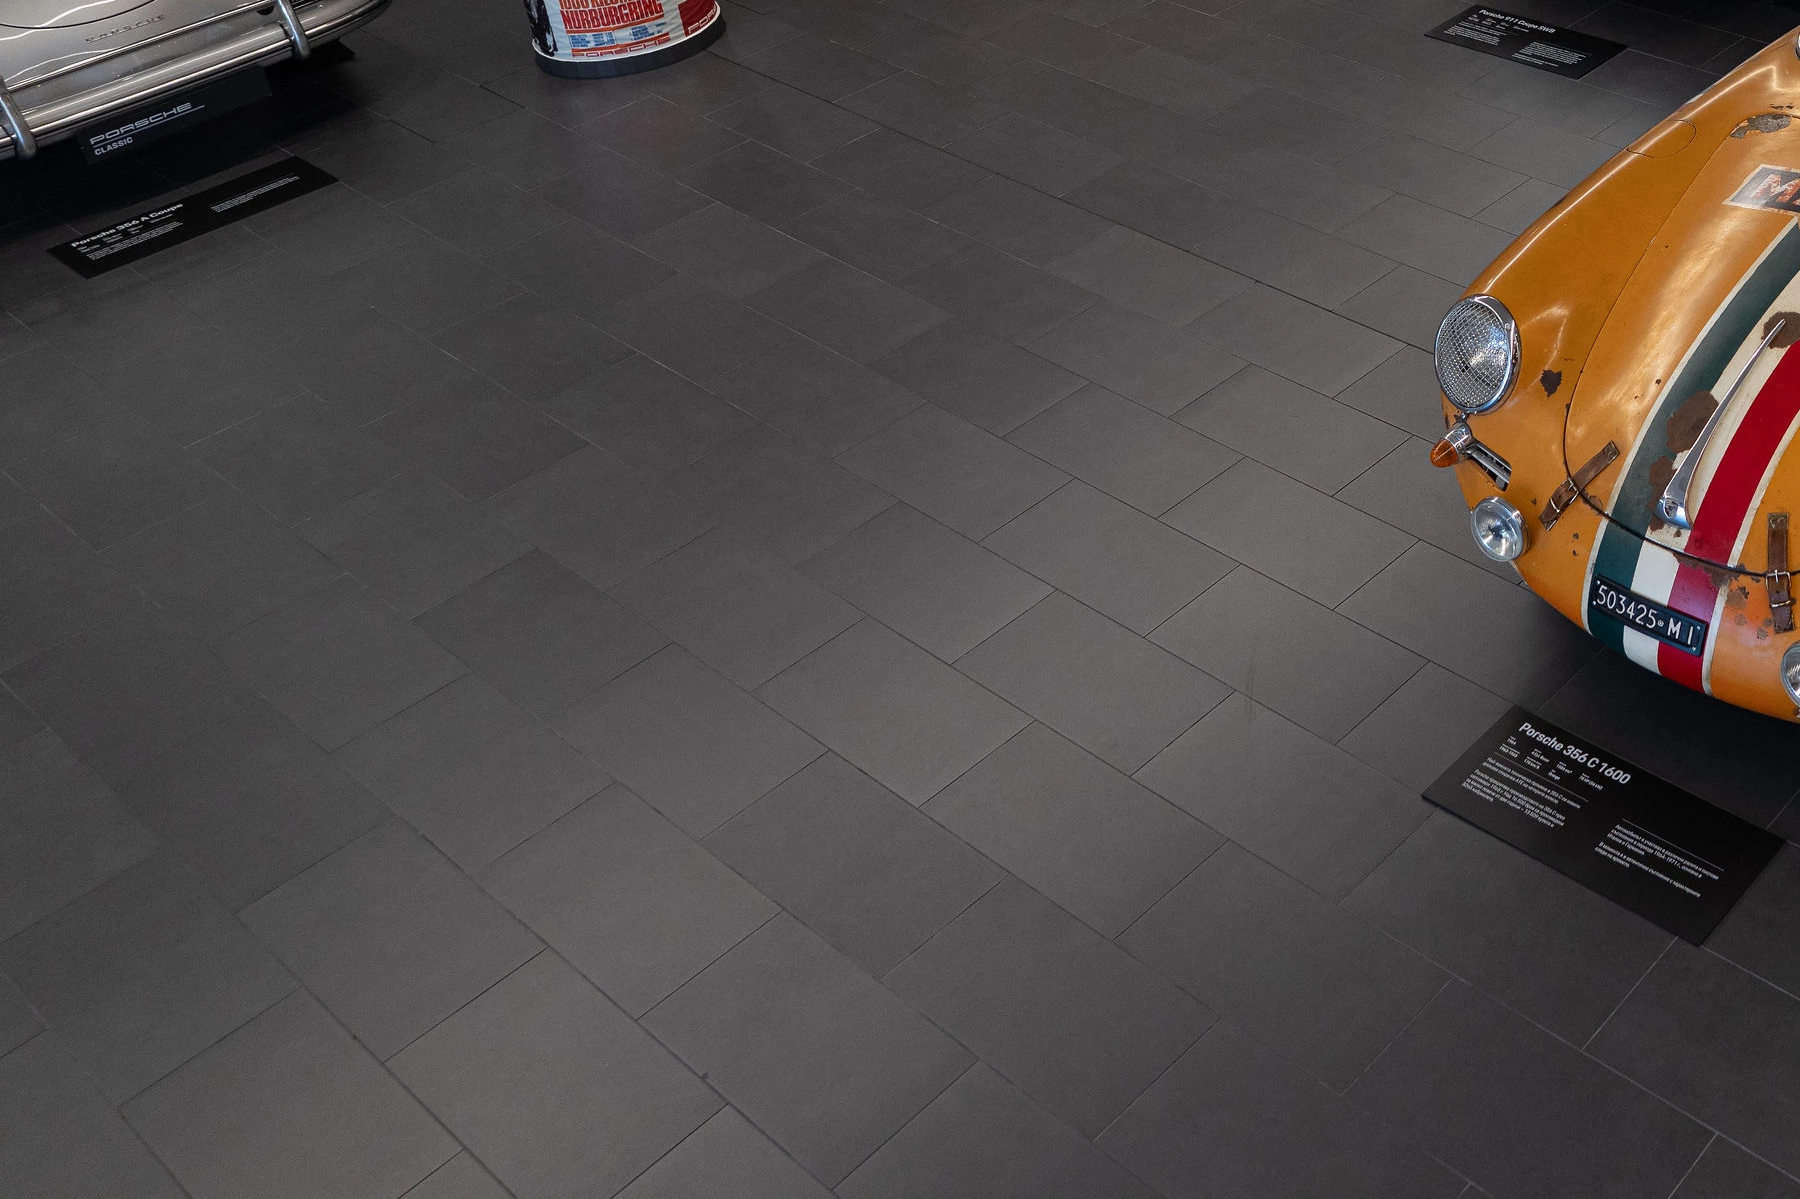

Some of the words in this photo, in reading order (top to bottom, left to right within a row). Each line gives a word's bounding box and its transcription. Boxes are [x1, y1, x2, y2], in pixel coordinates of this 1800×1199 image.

[1478, 9, 1504, 20] Porsche
[1505, 14, 1518, 24] 911
[1518, 18, 1538, 30] Coupe
[1538, 25, 1556, 34] SWB
[571, 35, 671, 58] PORSCHE
[88, 102, 192, 145] PORSCHE
[94, 136, 134, 156] CLASSIC
[70, 229, 116, 247] Porsche
[116, 220, 140, 232] 356
[149, 203, 184, 219] Coupe
[1596, 584, 1657, 629] 503425
[1518, 721, 1566, 751] Porsche
[1562, 744, 1590, 763] 356
[1586, 756, 1600, 768] C
[1596, 761, 1631, 784] 1600
